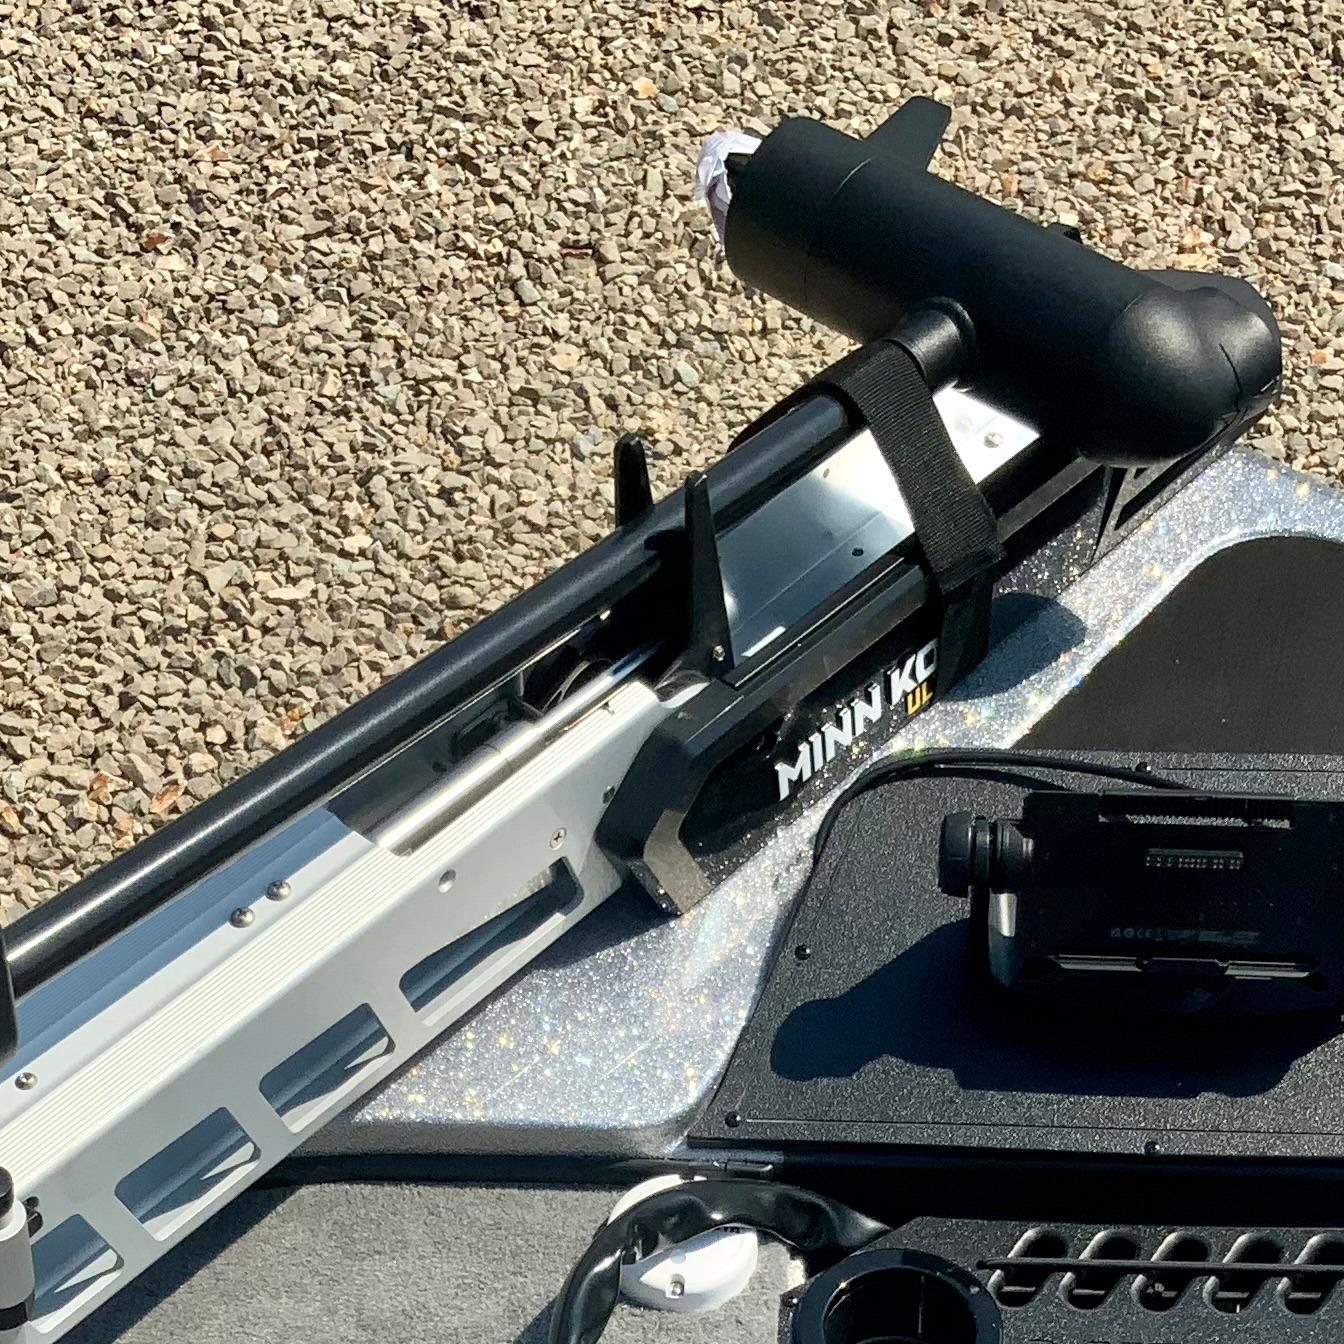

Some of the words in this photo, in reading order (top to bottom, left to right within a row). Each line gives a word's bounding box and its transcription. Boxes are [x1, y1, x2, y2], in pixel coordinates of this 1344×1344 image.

[774, 682, 882, 801] MINN
[887, 638, 939, 707] KO
[905, 680, 934, 716] UL
